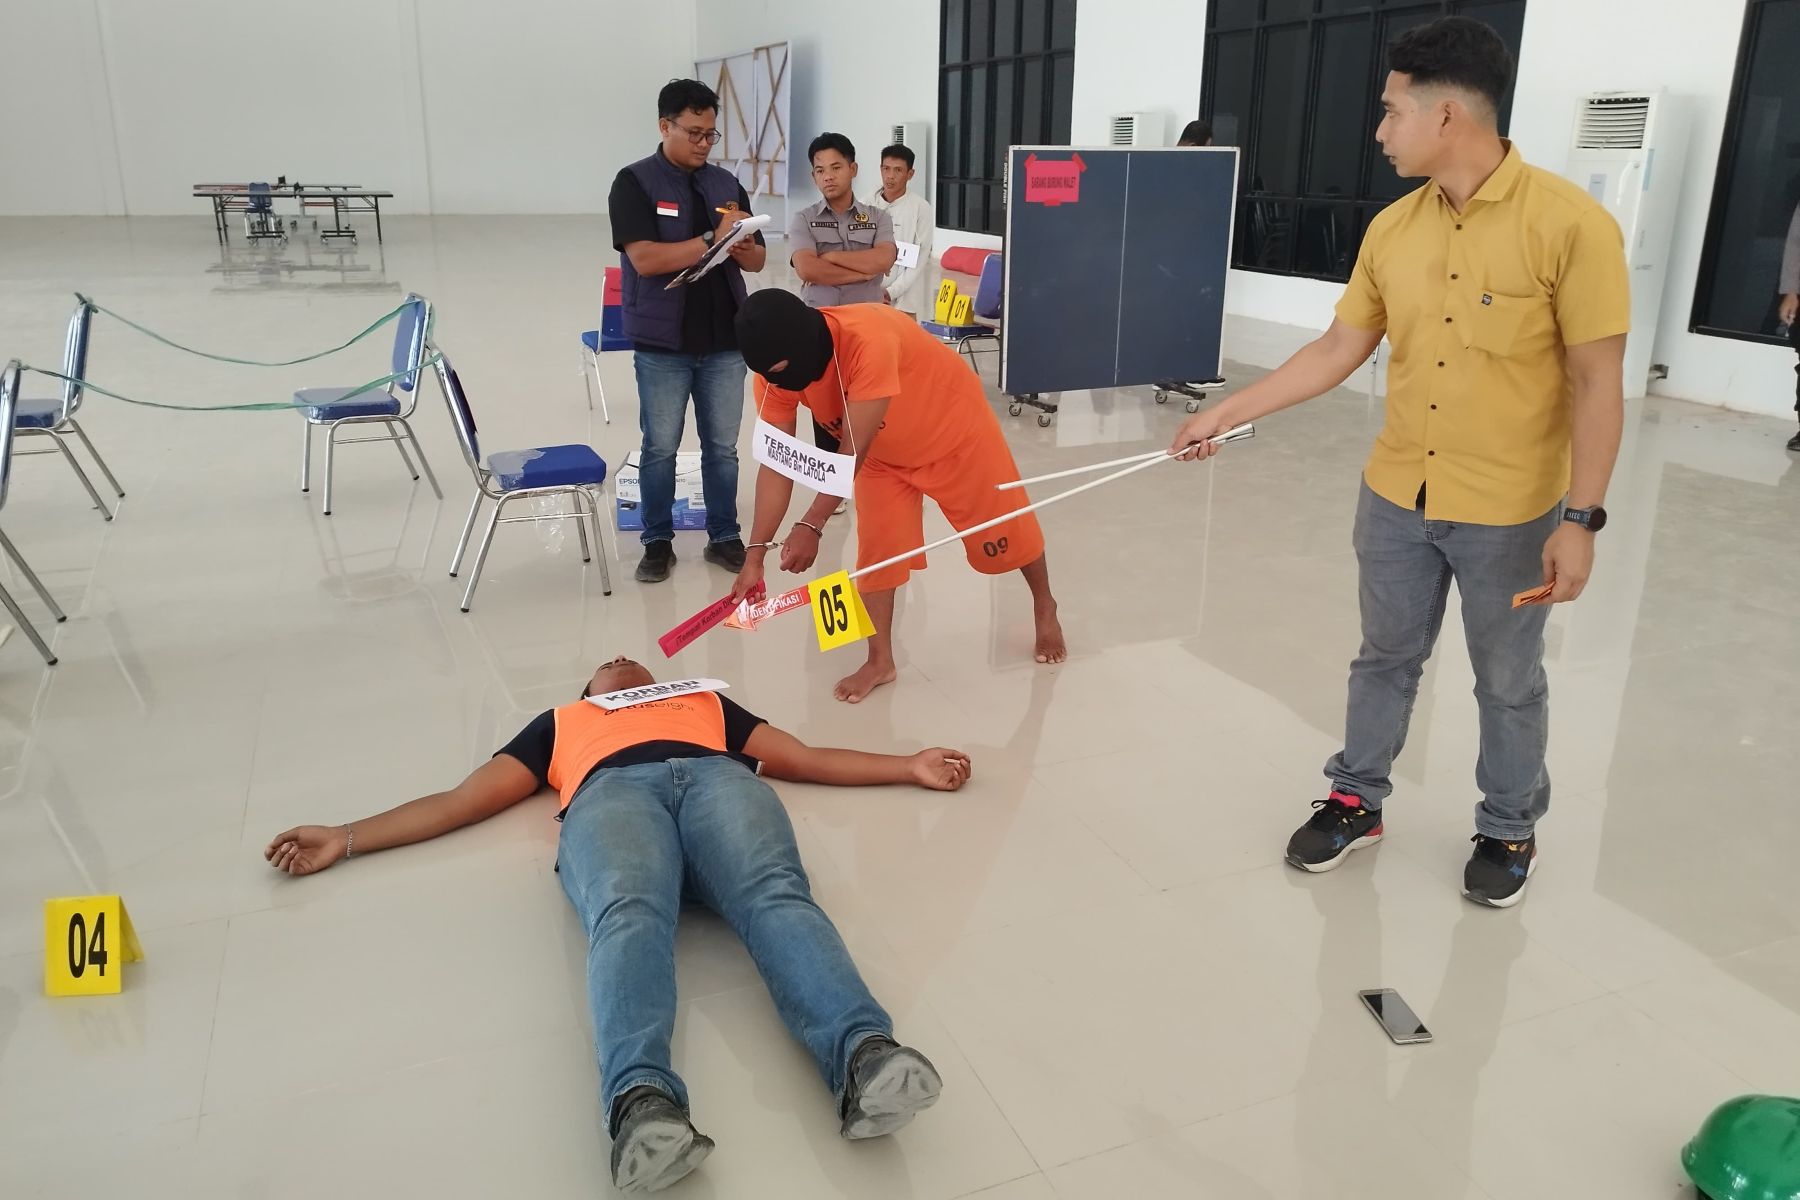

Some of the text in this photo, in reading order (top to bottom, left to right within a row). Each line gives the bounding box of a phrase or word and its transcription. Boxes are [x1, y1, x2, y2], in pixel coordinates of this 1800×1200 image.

[940, 284, 951, 303] 06
[955, 300, 967, 319] 01
[764, 433, 837, 475] TERSANGKA
[767, 446, 826, 483] MASTANG Bin LATOLA
[983, 536, 1008, 557] 09
[819, 584, 848, 636] 05
[604, 680, 699, 701] KORBAN
[68, 911, 108, 979] 04
